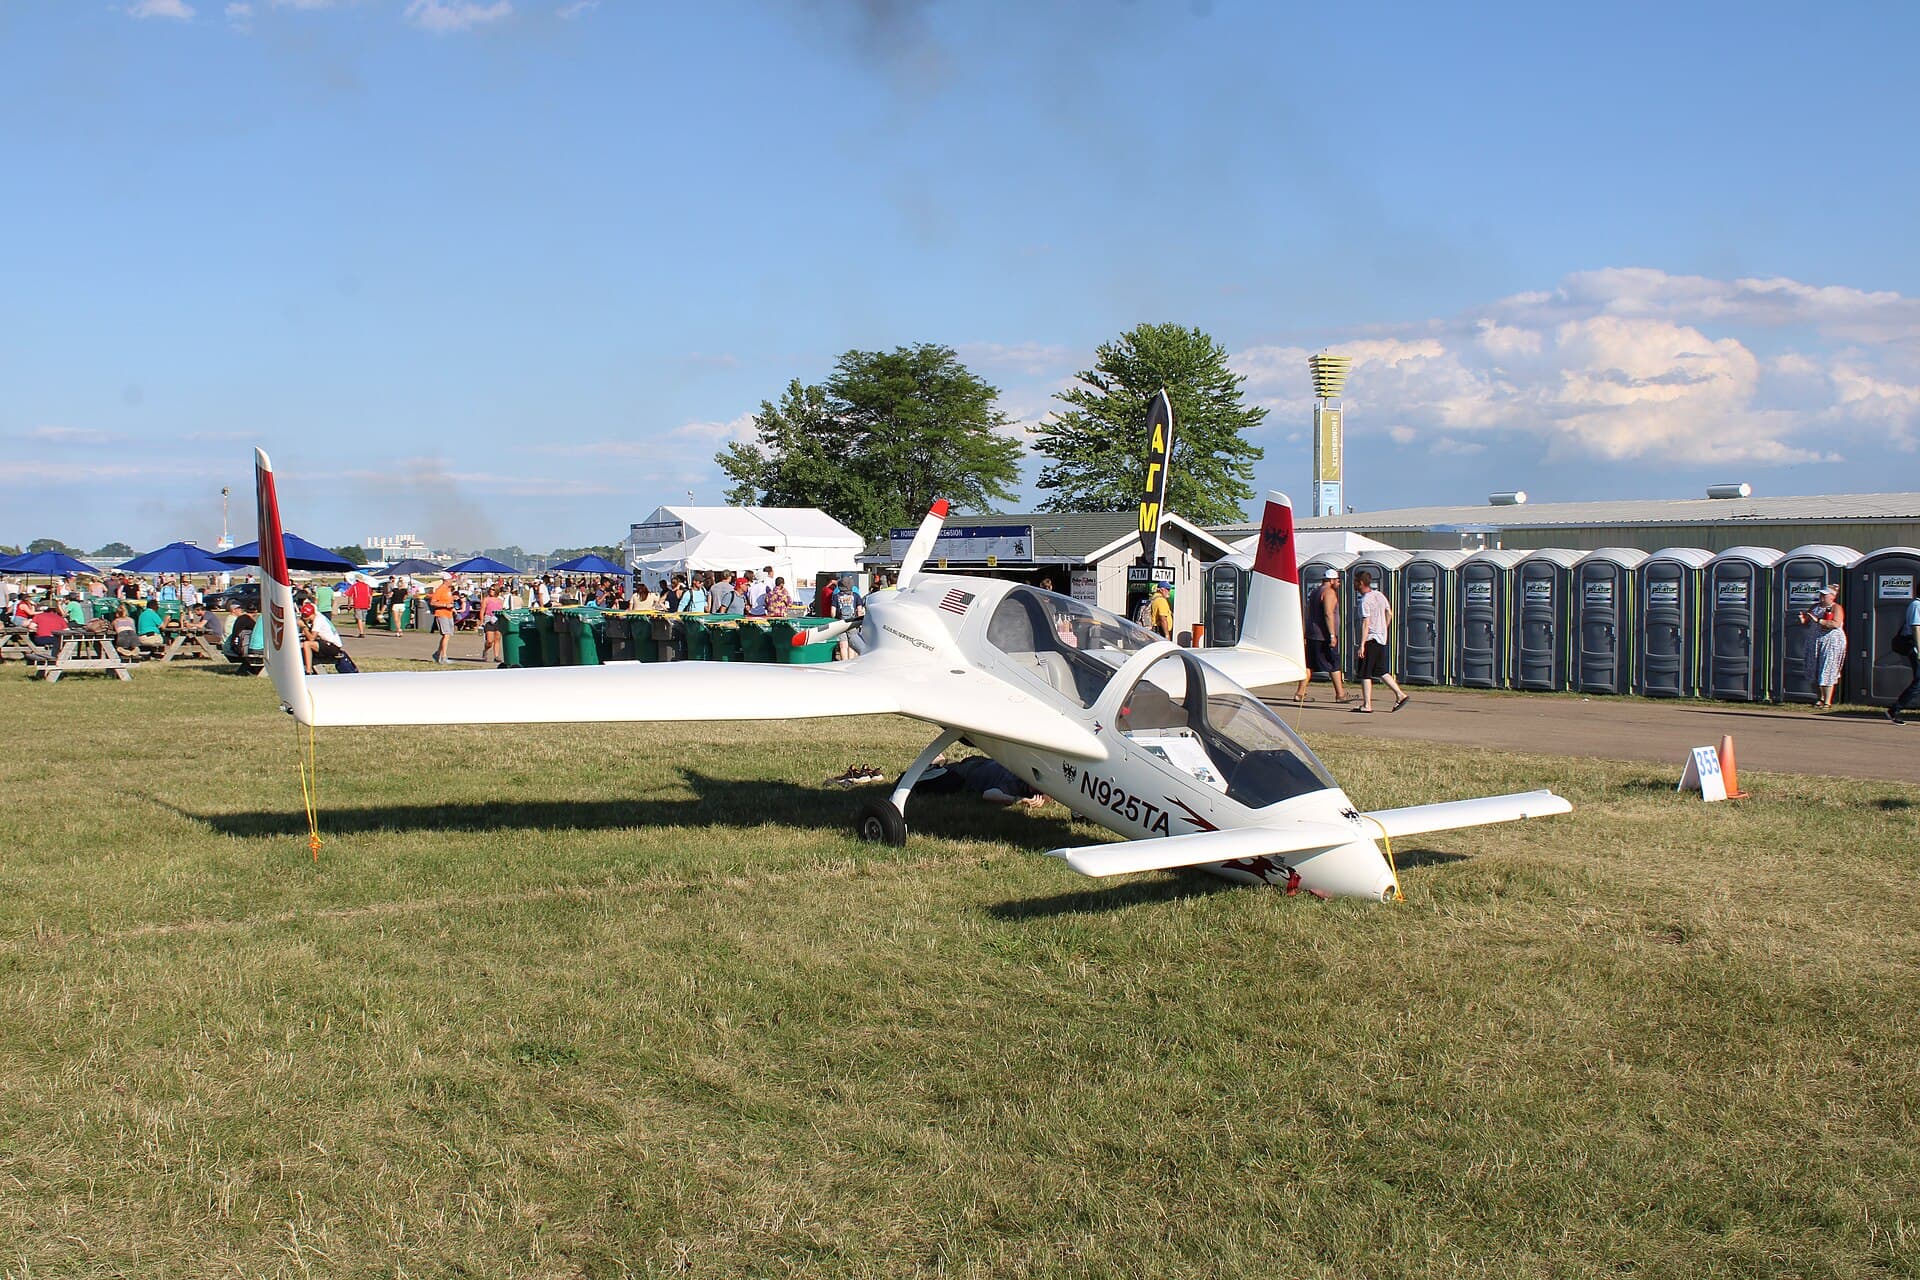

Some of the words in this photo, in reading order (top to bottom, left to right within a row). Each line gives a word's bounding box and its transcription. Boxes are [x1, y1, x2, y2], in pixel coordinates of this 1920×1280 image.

[1130, 570, 1147, 579] ATM
[1154, 570, 1172, 580] ATM
[1696, 749, 1720, 776] 355
[1081, 771, 1169, 837] N925TA
